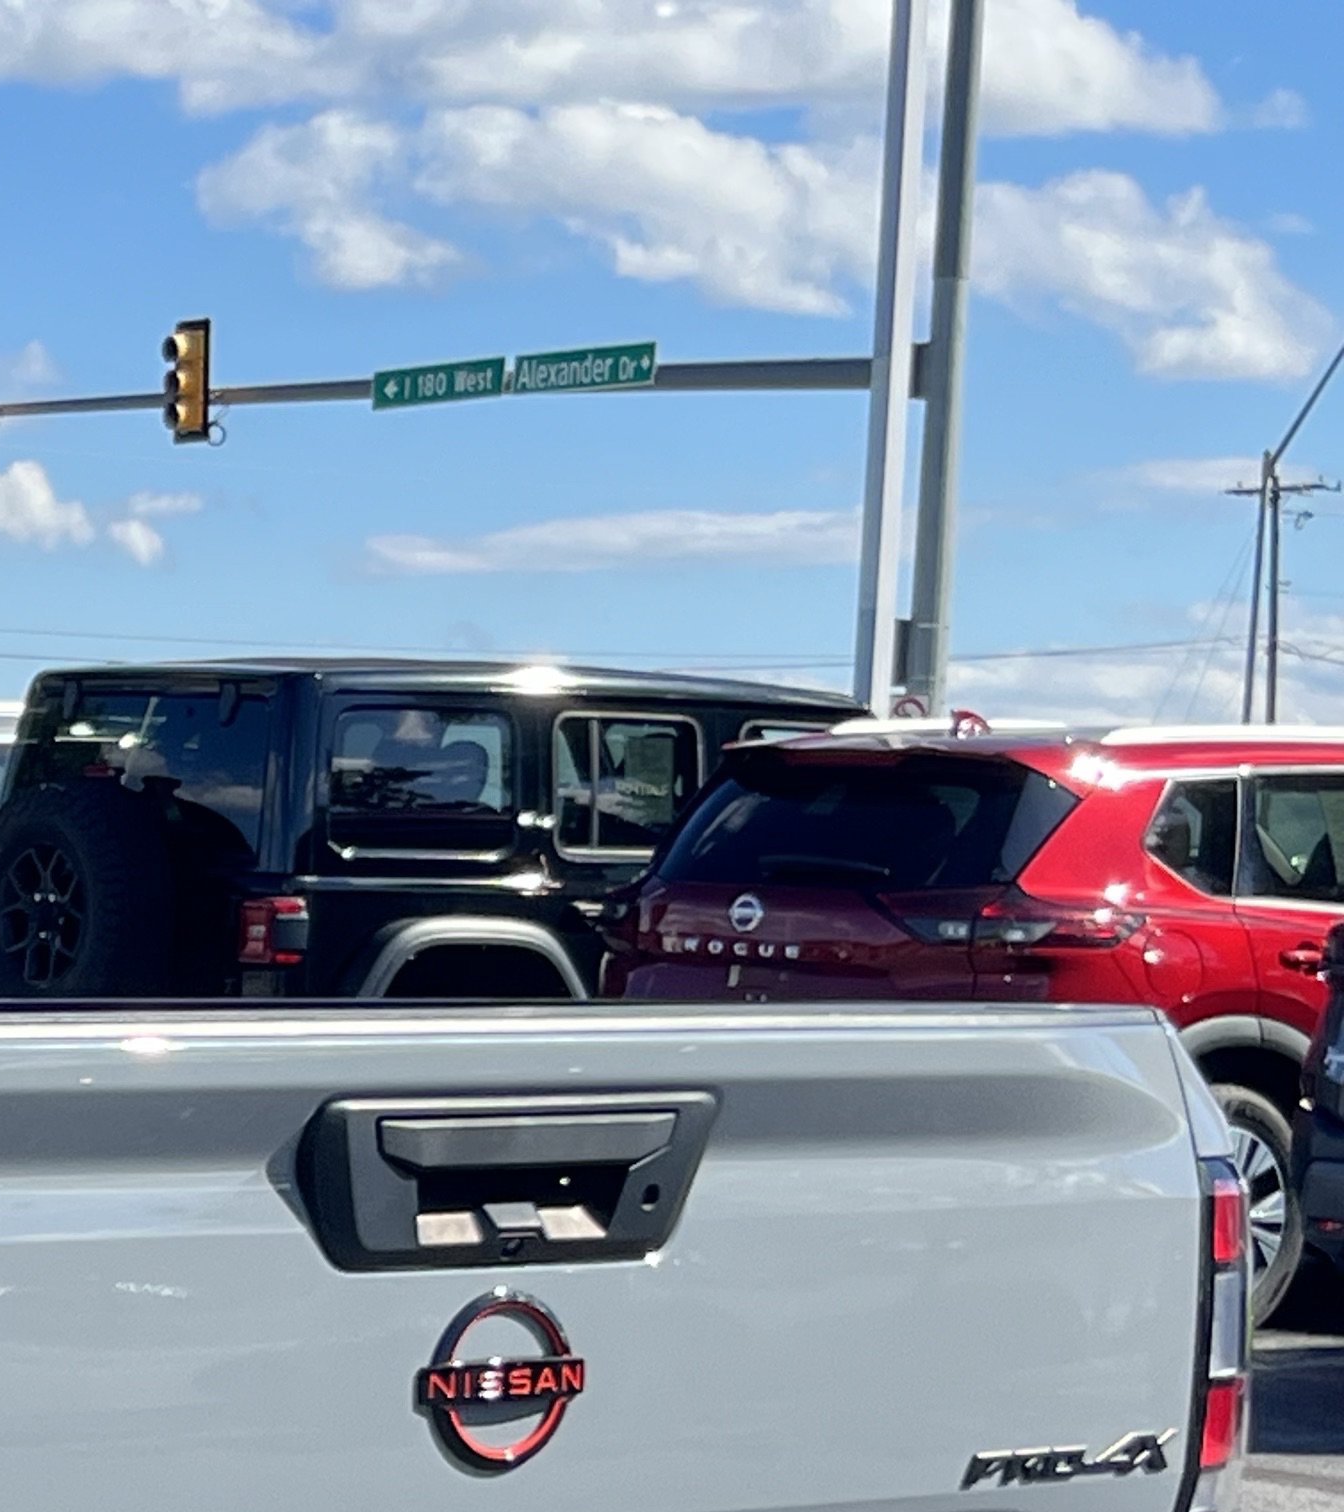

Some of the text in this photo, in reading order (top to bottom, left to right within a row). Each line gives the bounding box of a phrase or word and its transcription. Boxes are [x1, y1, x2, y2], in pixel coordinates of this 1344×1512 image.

[417, 372, 447, 398] 180
[454, 367, 492, 392] West
[516, 353, 638, 390] Alexander Dr
[426, 1362, 584, 1400] NISSAN
